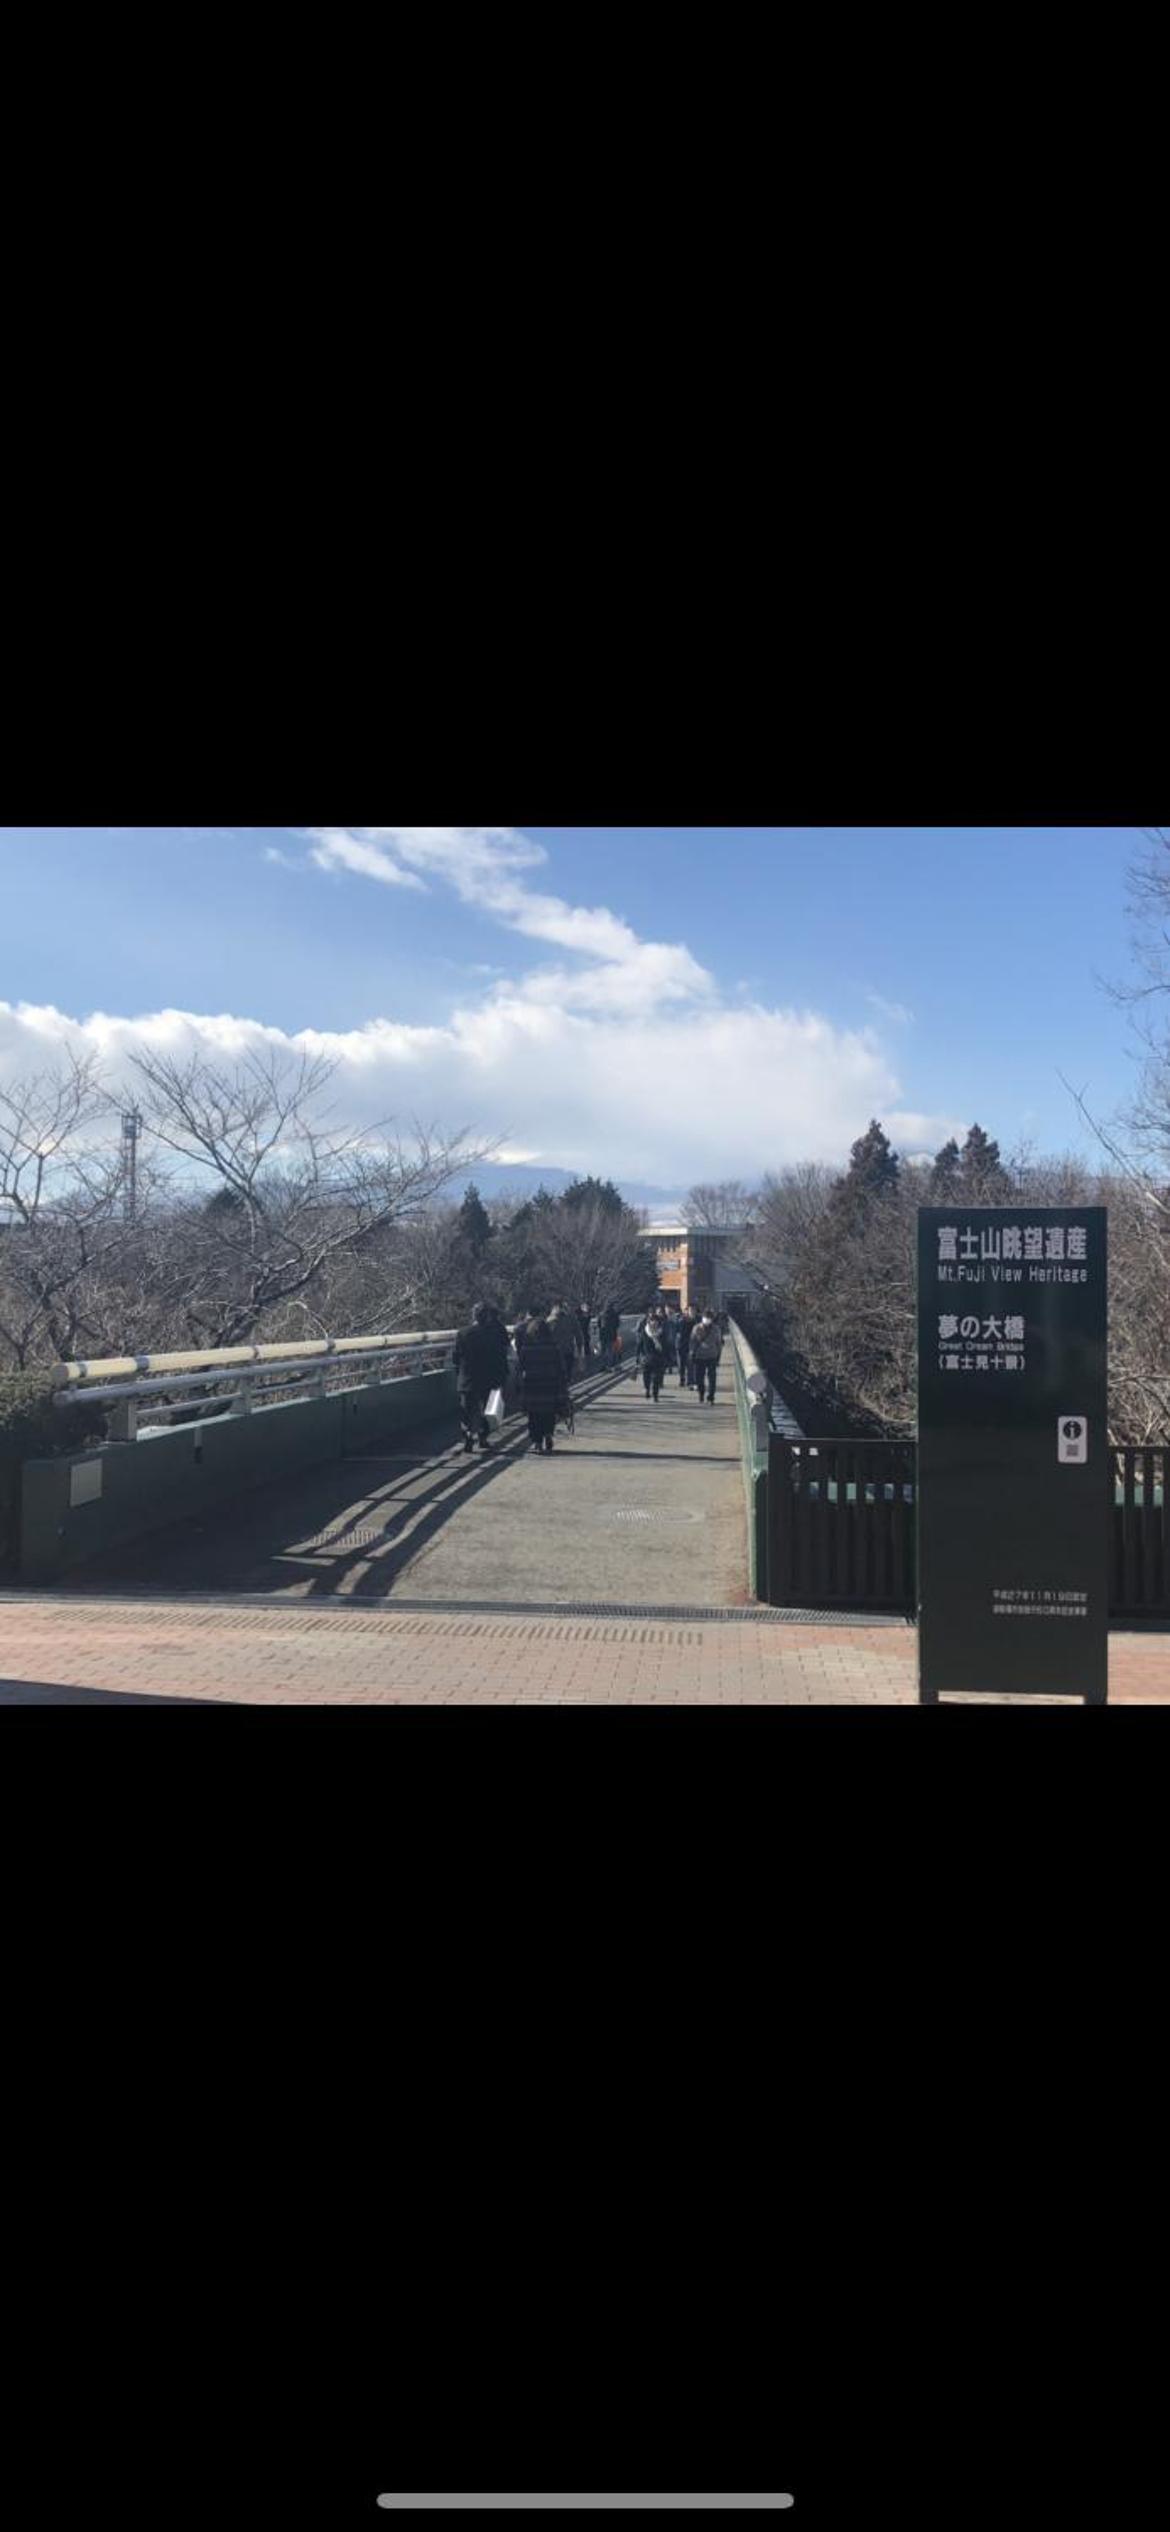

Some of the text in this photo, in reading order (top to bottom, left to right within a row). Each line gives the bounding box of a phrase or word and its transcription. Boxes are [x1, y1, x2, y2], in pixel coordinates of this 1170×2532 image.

[937, 1226, 1087, 1260] 富士山眺望遺産
[991, 1265, 1022, 1282] View
[1029, 1265, 1087, 1283] Heritage
[938, 1314, 1025, 1340] 夢の大橋
